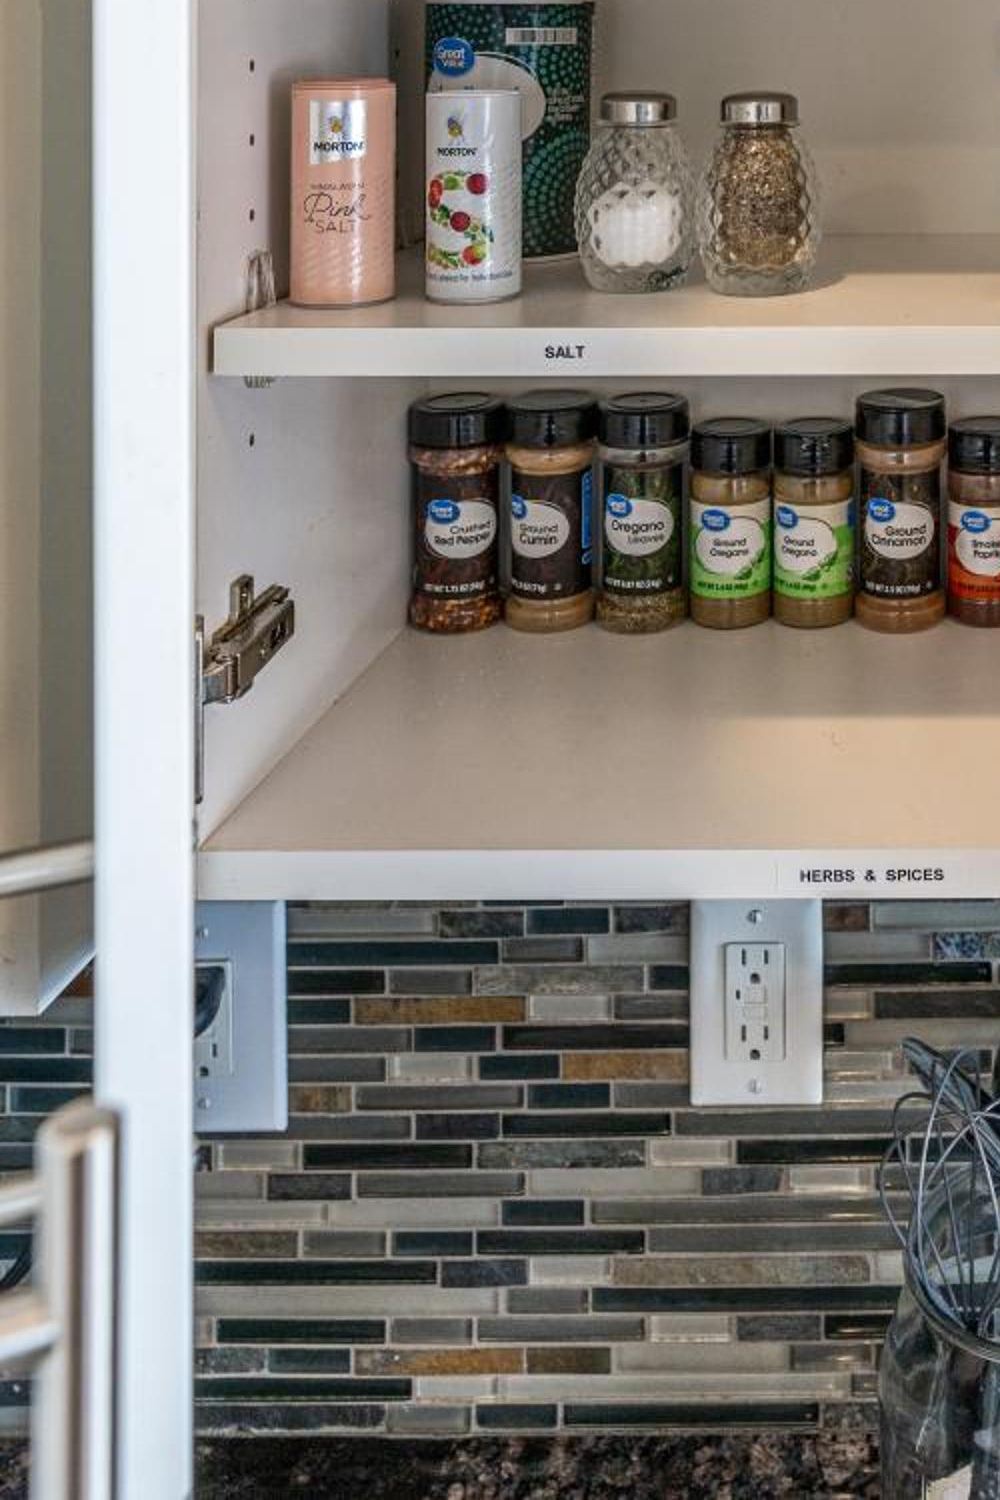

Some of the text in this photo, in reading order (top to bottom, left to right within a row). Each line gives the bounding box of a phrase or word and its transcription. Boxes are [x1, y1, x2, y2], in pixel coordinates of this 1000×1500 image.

[313, 141, 363, 153] MORTON
[437, 147, 476, 158] MORTON
[303, 191, 371, 223] Pink
[314, 220, 357, 234] SALT
[545, 345, 585, 359] SALT
[450, 520, 491, 535] Crushed
[519, 523, 559, 534] Ground
[611, 519, 665, 535] Oregano
[884, 524, 927, 537] Ground
[434, 532, 491, 546] Red Pepper
[519, 534, 558, 546] Cumin
[627, 533, 665, 545] Leaves
[713, 537, 747, 547] Ground
[783, 535, 815, 547] Ground
[871, 533, 927, 547] Cinnamon
[709, 548, 750, 558] Oregano
[781, 545, 818, 558] Oregano
[800, 868, 945, 883] HERBS & SPICES
